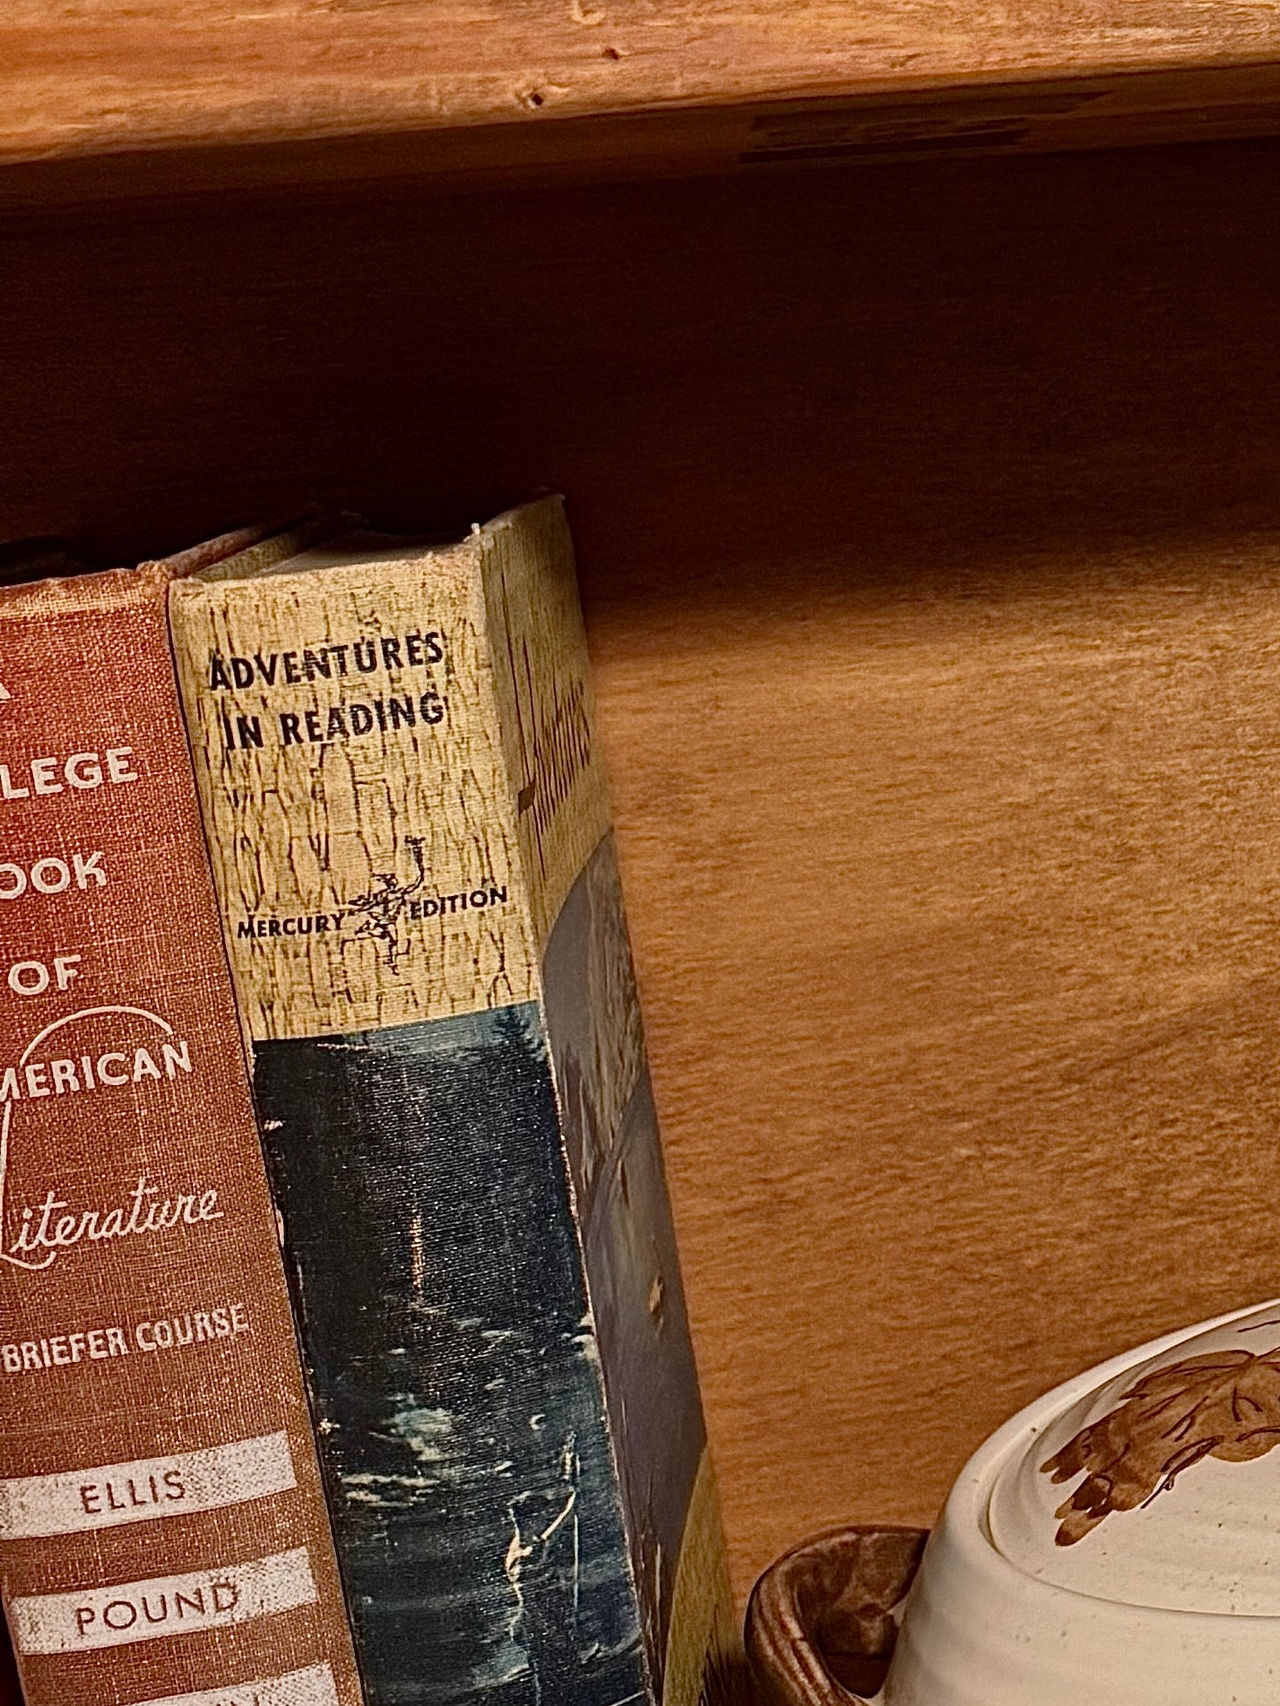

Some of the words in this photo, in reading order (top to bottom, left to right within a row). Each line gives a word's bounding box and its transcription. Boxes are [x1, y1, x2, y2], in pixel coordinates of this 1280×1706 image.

[210, 632, 444, 691] ADVENTURES
[222, 715, 264, 750] IN
[280, 692, 444, 746] READING
[237, 912, 346, 939] MERCURY
[409, 886, 508, 920] EDITION
[8, 955, 82, 995] OF
[2, 1326, 129, 1372] BRIEFER
[136, 1302, 249, 1351] COURSE
[80, 1470, 186, 1515] ELLIS
[76, 1580, 240, 1637] POUND
